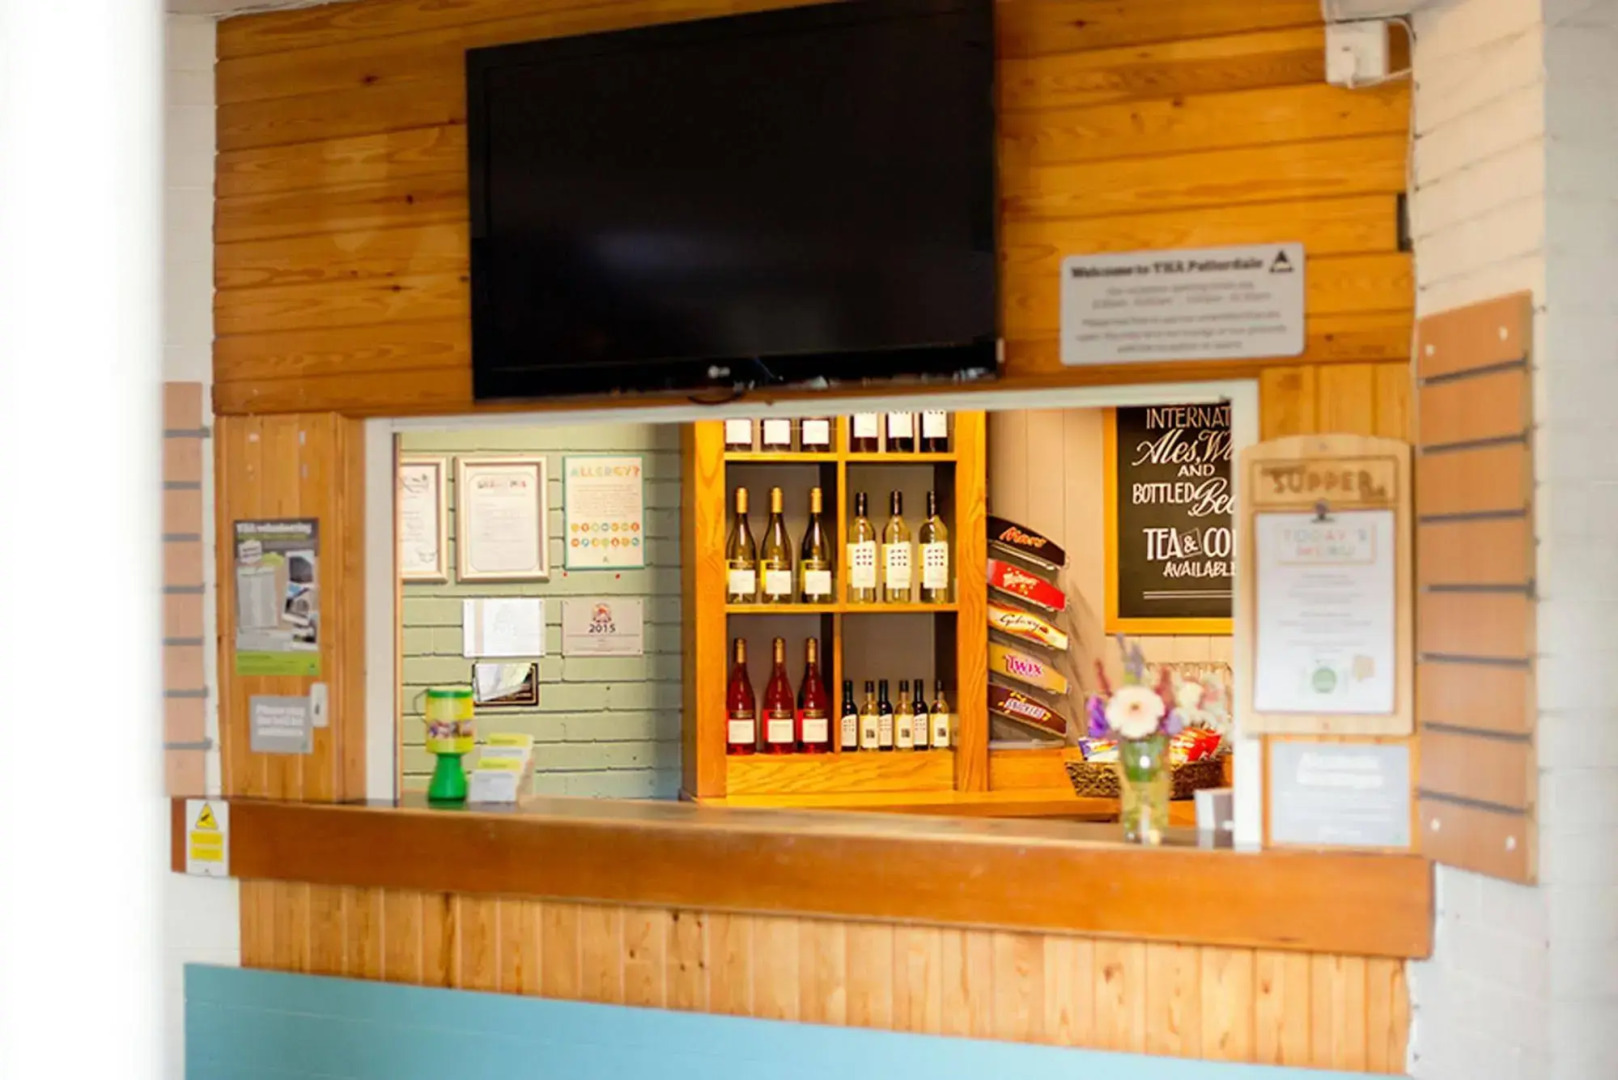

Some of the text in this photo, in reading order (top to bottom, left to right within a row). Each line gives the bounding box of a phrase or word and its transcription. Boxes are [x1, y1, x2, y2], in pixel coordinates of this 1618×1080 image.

[1177, 463, 1216, 477] AND
[1132, 482, 1195, 505] BOTTLED
[1142, 527, 1183, 560] TEA
[1183, 534, 1199, 554] &
[588, 622, 617, 634] 2015
